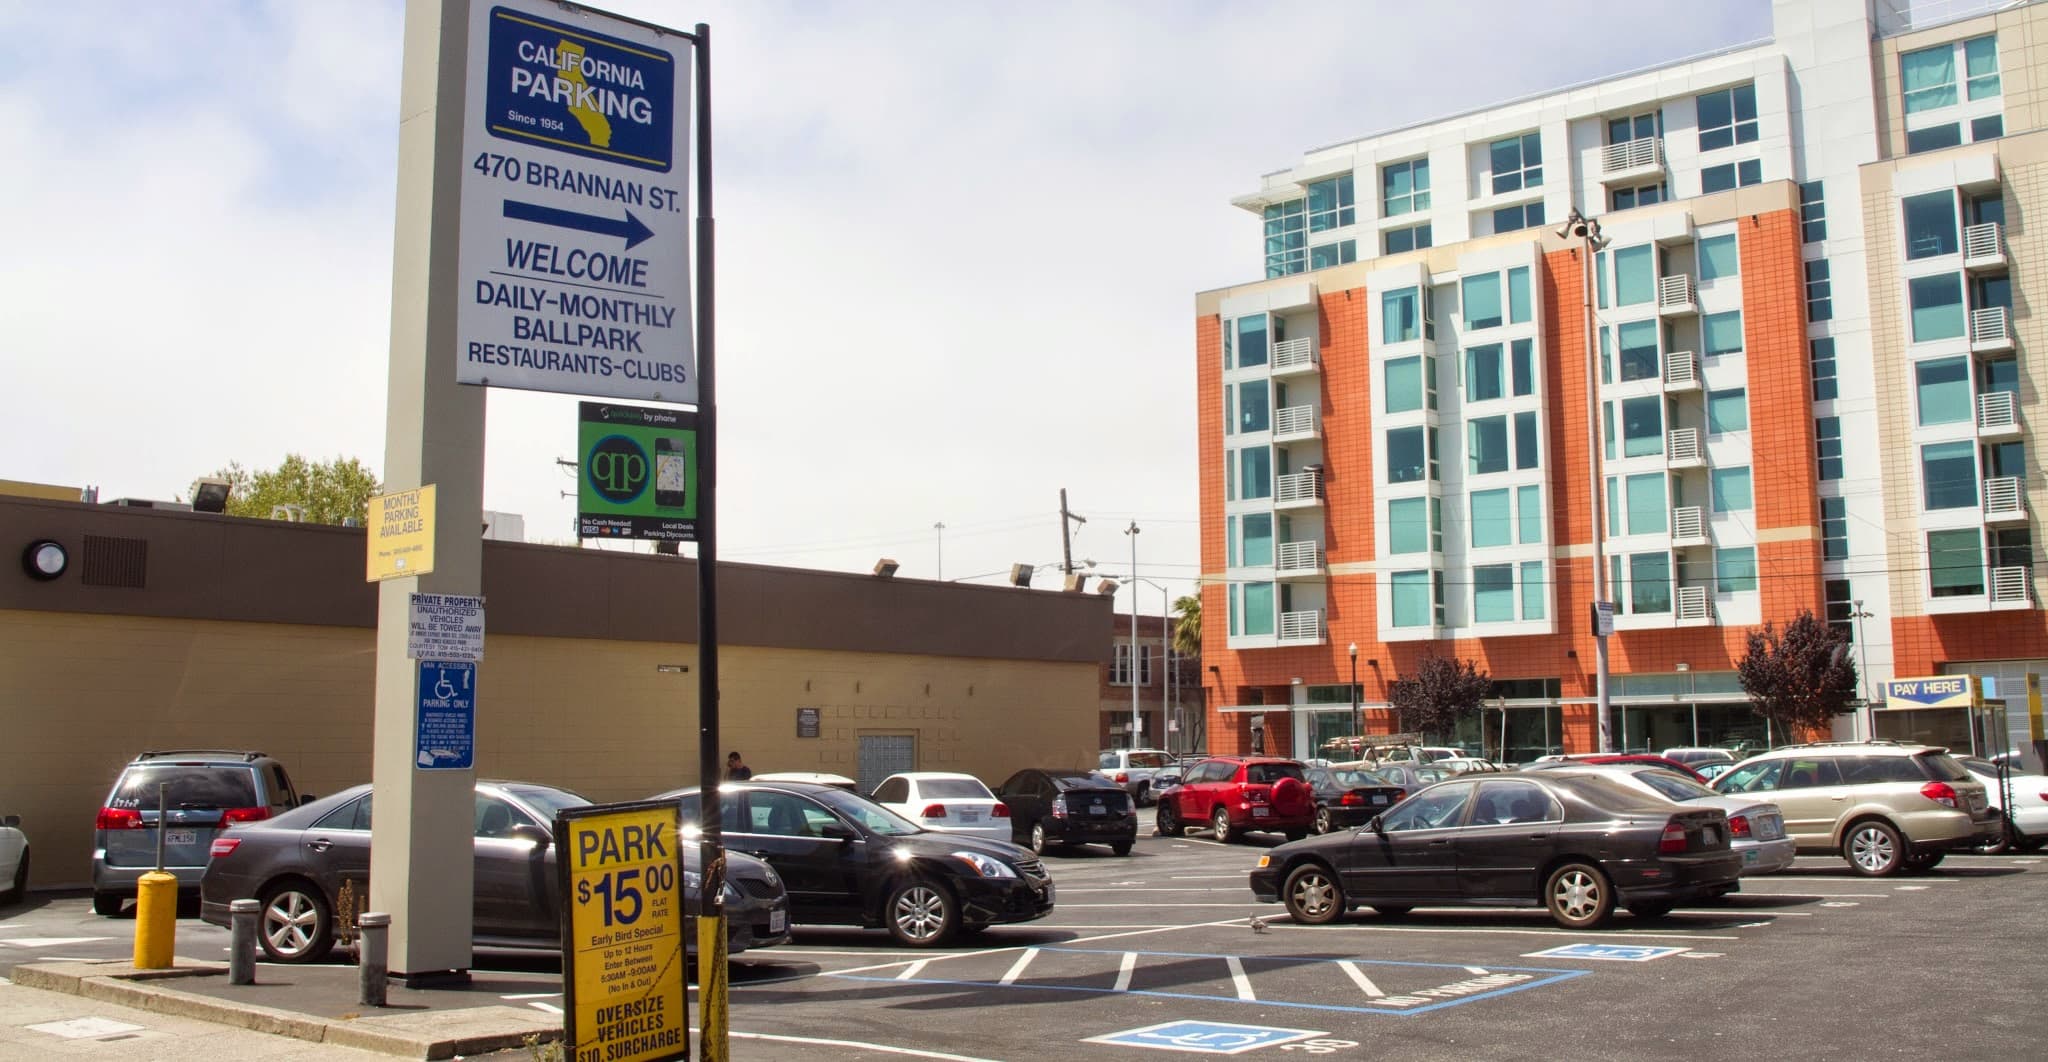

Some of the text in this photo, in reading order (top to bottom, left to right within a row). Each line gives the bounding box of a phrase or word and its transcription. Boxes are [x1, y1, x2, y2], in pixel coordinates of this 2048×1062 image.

[518, 40, 645, 90] CALIFORNIA
[511, 67, 652, 124] PARKING
[508, 110, 564, 131] Since 1954
[474, 152, 681, 213] 470 BRANNAN ST.
[506, 238, 649, 288] WELCOME
[476, 280, 676, 329] DAILY-MONTHLY
[514, 316, 643, 353] BALLPARK
[468, 342, 686, 383] RESTAURANTS-CLUBS
[654, 414, 677, 424] phone
[384, 490, 421, 510] MONTHLY
[385, 507, 418, 523] PARKING
[380, 519, 423, 538] AVAILABLE
[644, 529, 665, 539] Parking
[412, 594, 482, 607] PRIVATE PROPERTY
[417, 606, 476, 616] UNAUTHORIZED
[429, 615, 464, 624] VEHICLES
[440, 624, 462, 632] TOWED
[465, 625, 482, 633] AWAY
[438, 662, 473, 670] ACCESSIBLE
[1893, 681, 1962, 696] PAY HERE
[423, 699, 470, 709] PARKING ONLY
[578, 822, 667, 867] PARK
[652, 897, 667, 907] FLAT
[652, 909, 668, 918] RATE
[592, 924, 664, 946] Early Bird Special
[604, 943, 653, 959] Up to 12 Hours
[605, 955, 653, 970] Enter Between
[608, 983, 621, 994] (No
[622, 982, 629, 991] In
[637, 978, 652, 988] Out)
[1410, 973, 1534, 998] PARKING
[597, 995, 664, 1025] OVERSIZE
[597, 1013, 664, 1043] VEHICLES
[607, 1027, 681, 1062] SURCHARGE
